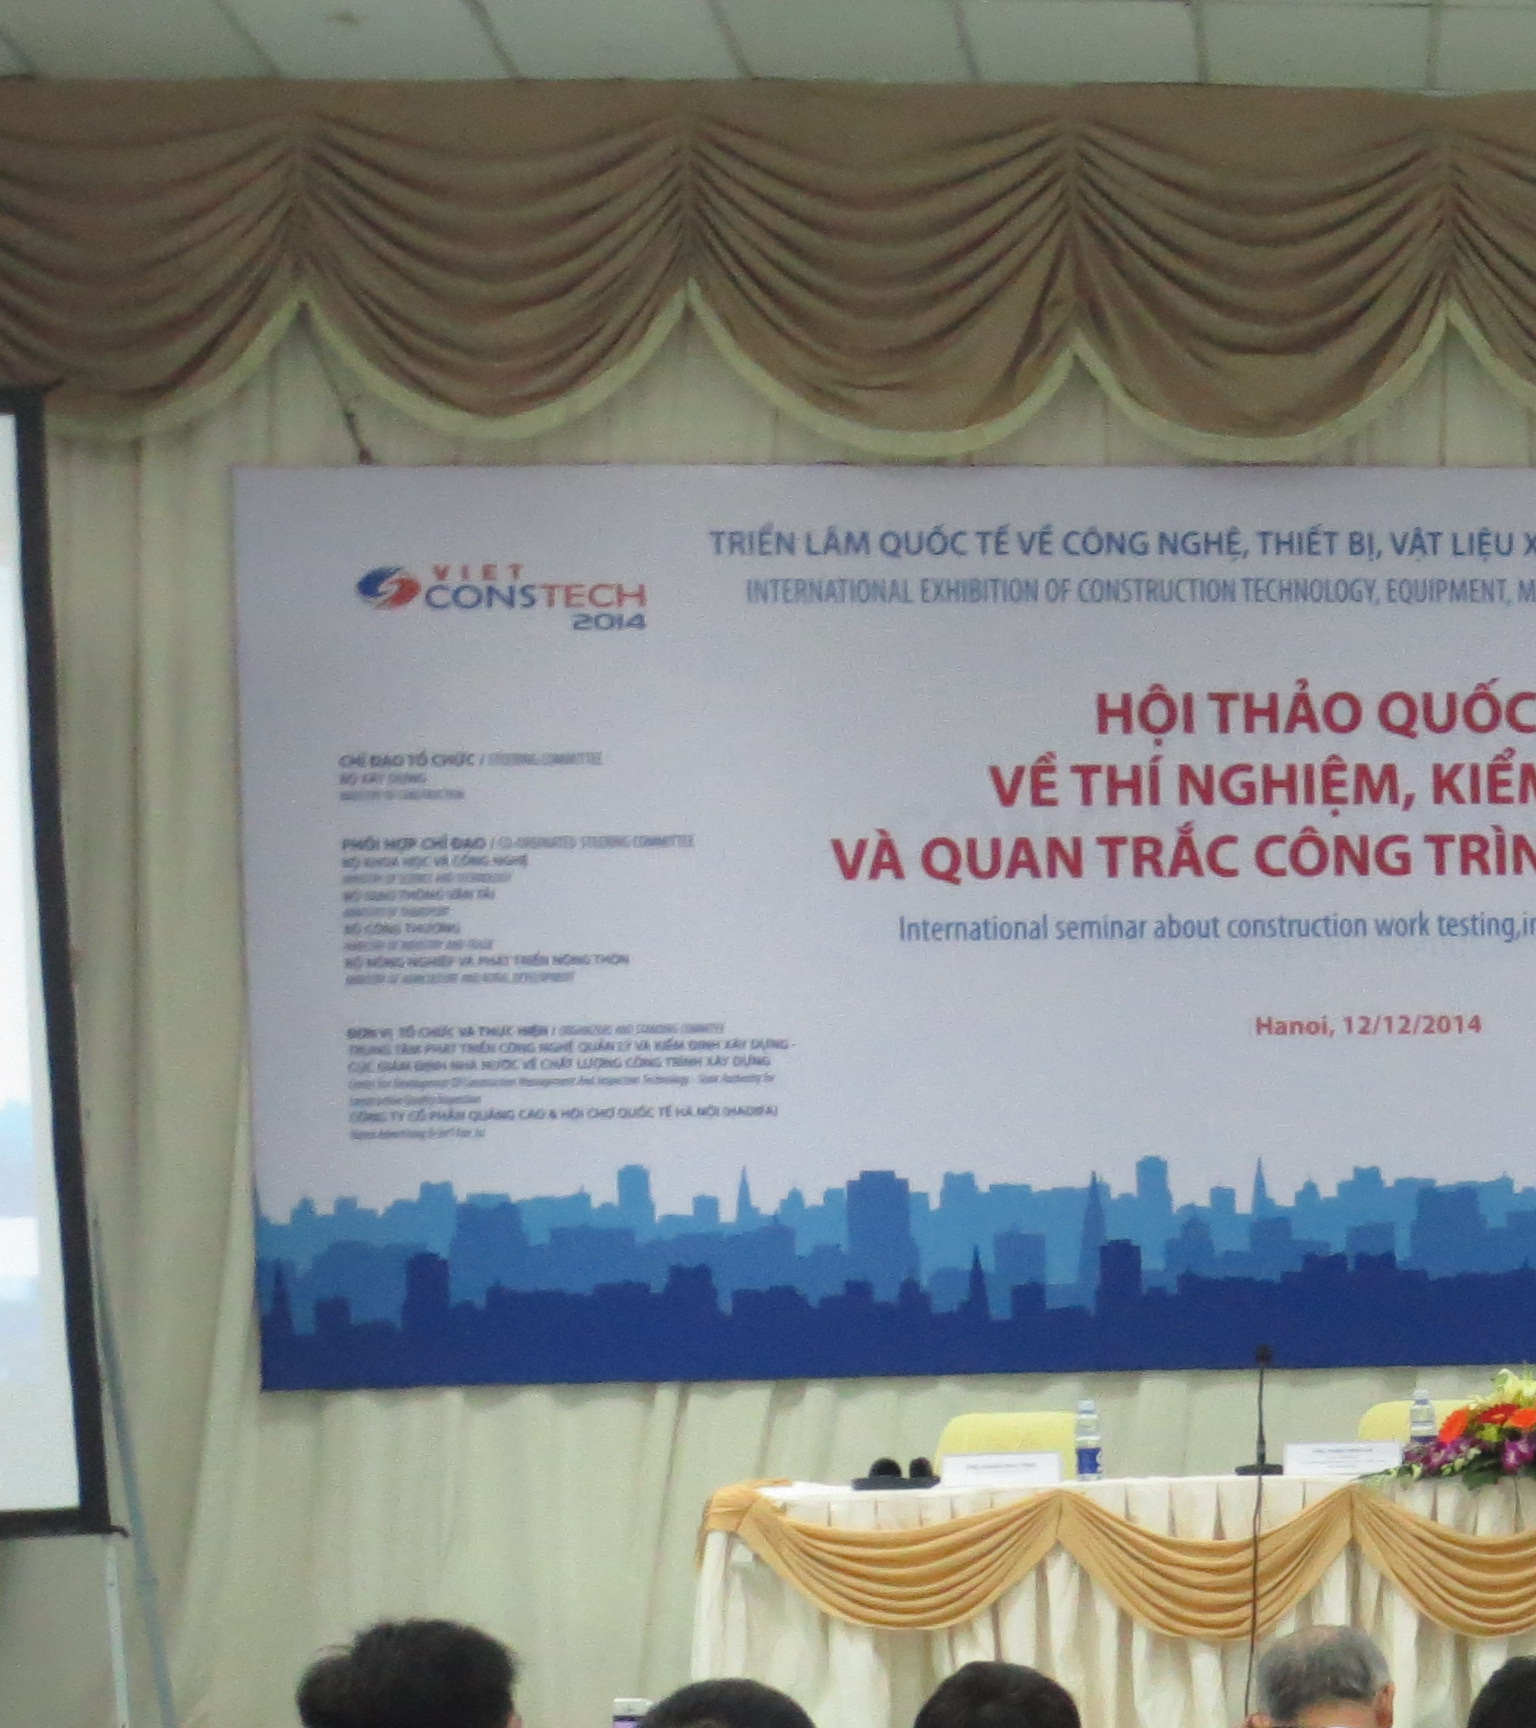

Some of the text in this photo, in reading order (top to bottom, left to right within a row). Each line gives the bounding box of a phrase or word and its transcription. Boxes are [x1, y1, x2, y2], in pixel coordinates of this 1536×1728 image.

[709, 520, 797, 557] TRIỂN
[805, 524, 871, 557] LÃM
[879, 522, 968, 559] QUỐC
[975, 522, 1012, 556] TẾ
[1017, 523, 1054, 557] VỀ
[1062, 525, 1149, 558] CÔNG
[1157, 525, 1250, 562] NGHỆ,
[1257, 522, 1340, 557] THIẾT
[1348, 529, 1382, 562] BỊ,
[1390, 526, 1444, 562] VẬT
[1453, 527, 1514, 563] LIỆU
[433, 562, 525, 581] VIET
[424, 583, 648, 610] CONSTECH
[746, 577, 914, 605] INTERNATIONAL
[920, 577, 1039, 605] EXHIBITION
[1044, 577, 1072, 605] OF
[1077, 577, 1237, 605] CONSTRUCTION
[1241, 577, 1381, 606] TECHNOLOGY,
[572, 613, 647, 631] 2014
[1095, 681, 1194, 747] HỘI
[1206, 677, 1364, 736] THẢO
[988, 750, 1059, 808] VỀ
[1069, 753, 1164, 807] THÍ
[1178, 753, 1416, 818] NGHIỆM,
[830, 828, 906, 881] VÀ
[919, 836, 1084, 885] QUAN
[1095, 820, 1240, 878] TRẮC
[1254, 825, 1412, 877] CÔNG
[898, 912, 1049, 942] International
[1054, 916, 1145, 941] seminar
[1153, 913, 1220, 939] about
[1225, 912, 1368, 938] construction
[1373, 910, 1431, 937] work
[1255, 1010, 1483, 1040] Hanoi, 12/12/2014
